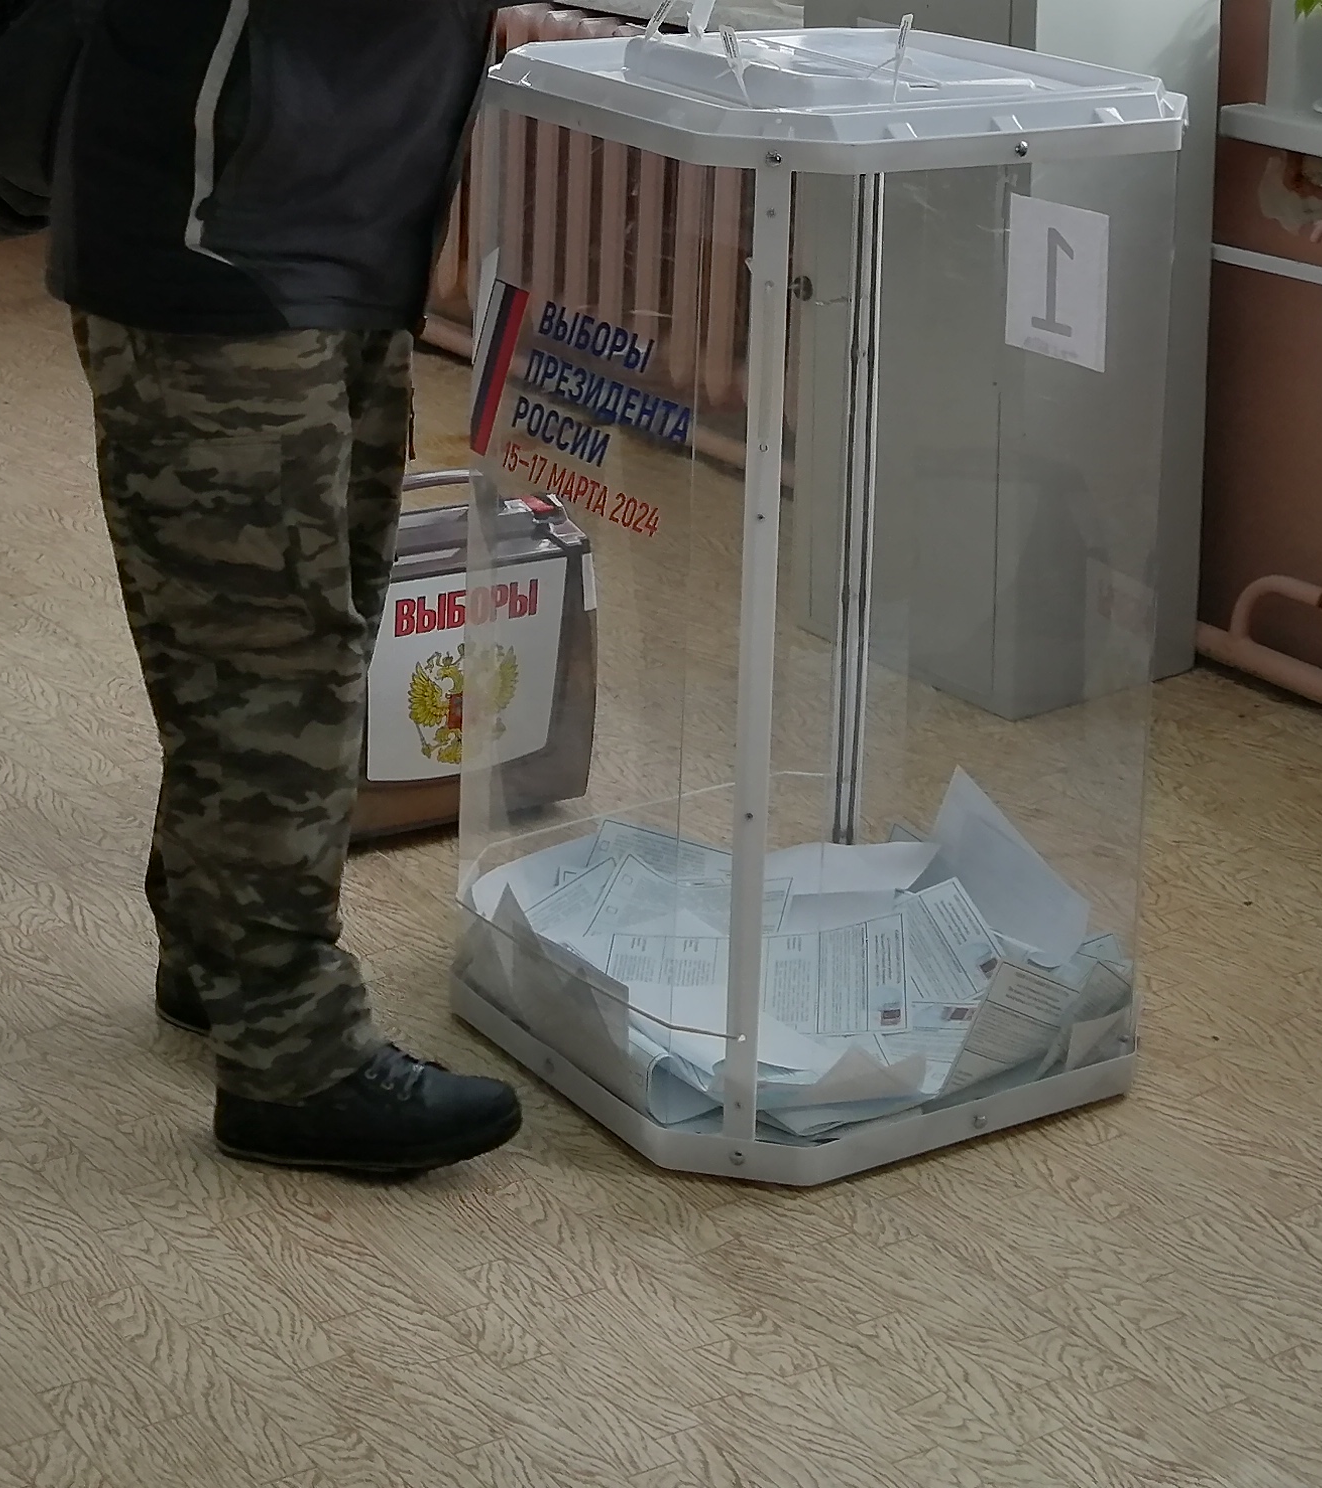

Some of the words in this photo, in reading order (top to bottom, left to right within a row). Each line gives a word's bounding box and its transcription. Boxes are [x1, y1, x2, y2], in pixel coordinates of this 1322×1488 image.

[538, 301, 656, 374] ВЫБОРЫ
[511, 396, 611, 468] РОССИИ
[523, 348, 692, 444] ПРЕЗИДЕНТА
[546, 461, 609, 516] МАРТА
[608, 491, 661, 539] 2024
[393, 578, 539, 639] ВЫБОРЫ
